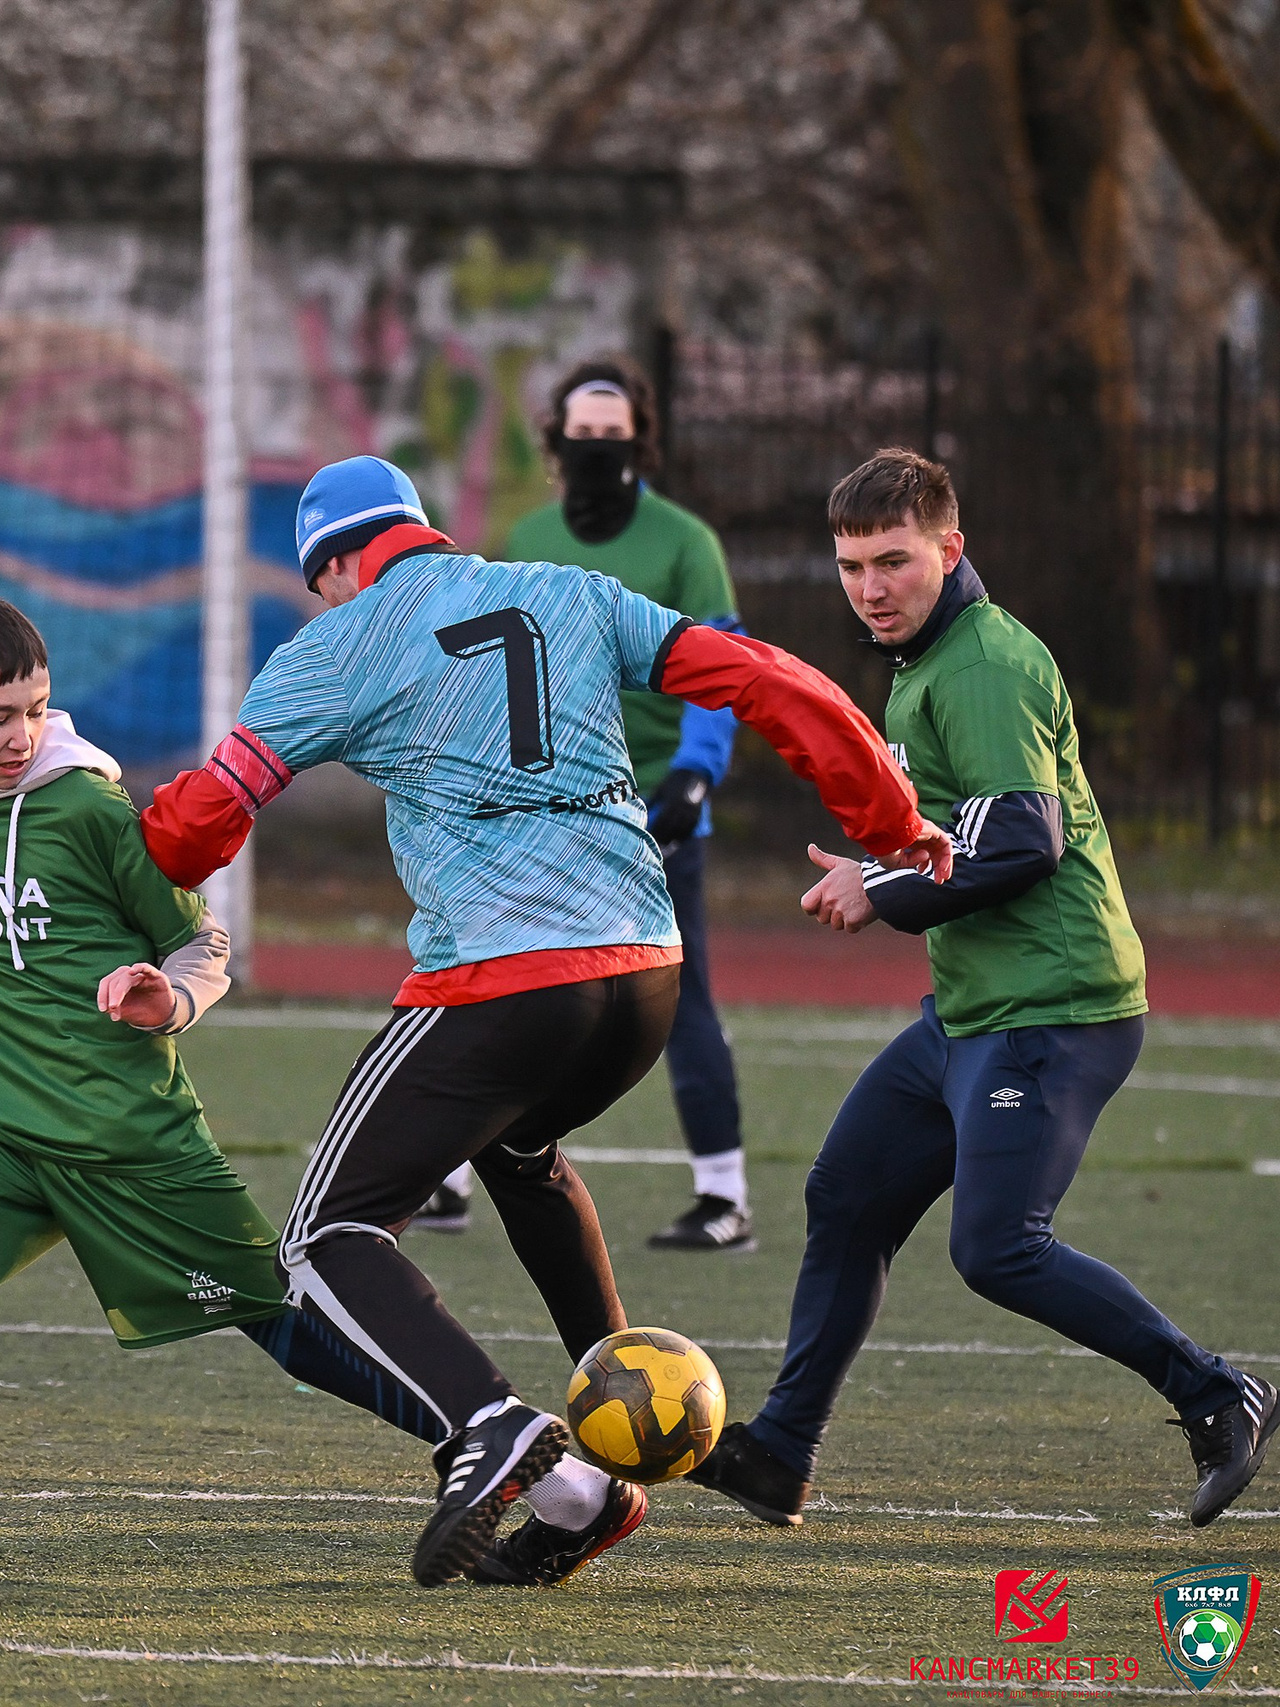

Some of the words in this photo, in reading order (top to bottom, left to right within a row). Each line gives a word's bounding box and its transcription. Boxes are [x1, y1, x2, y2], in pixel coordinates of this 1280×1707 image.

[433, 606, 555, 775] 7
[549, 780, 639, 814] SportT
[991, 1100, 1021, 1108] umbro
[187, 1286, 237, 1300] BALTIA
